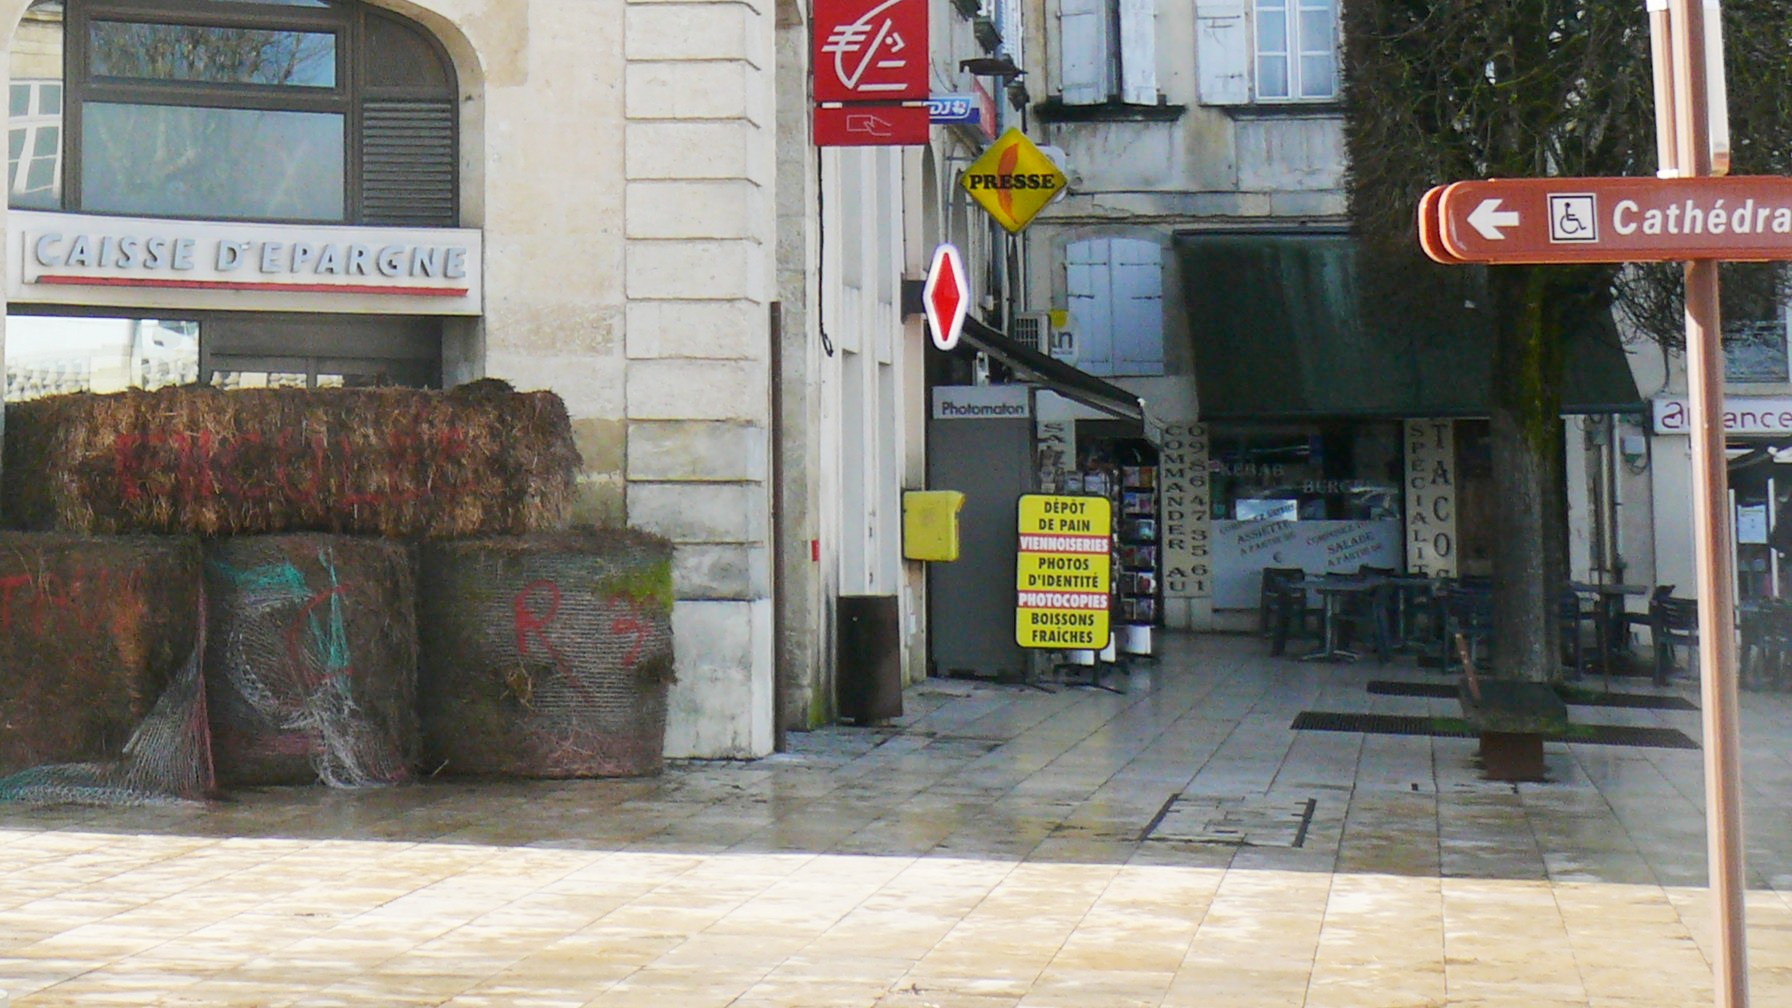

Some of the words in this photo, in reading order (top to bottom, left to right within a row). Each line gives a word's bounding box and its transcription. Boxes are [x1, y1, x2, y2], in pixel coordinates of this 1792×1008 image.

[969, 173, 1056, 190] PRESSE
[35, 232, 197, 271] CAISSE
[217, 239, 468, 280] D'EPARGNE
[941, 401, 1025, 416] Photomaton
[1164, 425, 1186, 551] COMMANDER
[1043, 497, 1086, 515] DÉPÔT
[1039, 517, 1057, 531] DE
[1060, 517, 1091, 532] PAIN
[1019, 535, 1110, 553] VIENNOISERIES
[1038, 556, 1090, 571] PHOTOS
[1028, 571, 1100, 589] D'IDENTITÉ
[1018, 591, 1109, 609] PHOTOCOPIES
[1031, 611, 1095, 627] BOISSONS
[1032, 626, 1094, 644] FRAÎCHES
